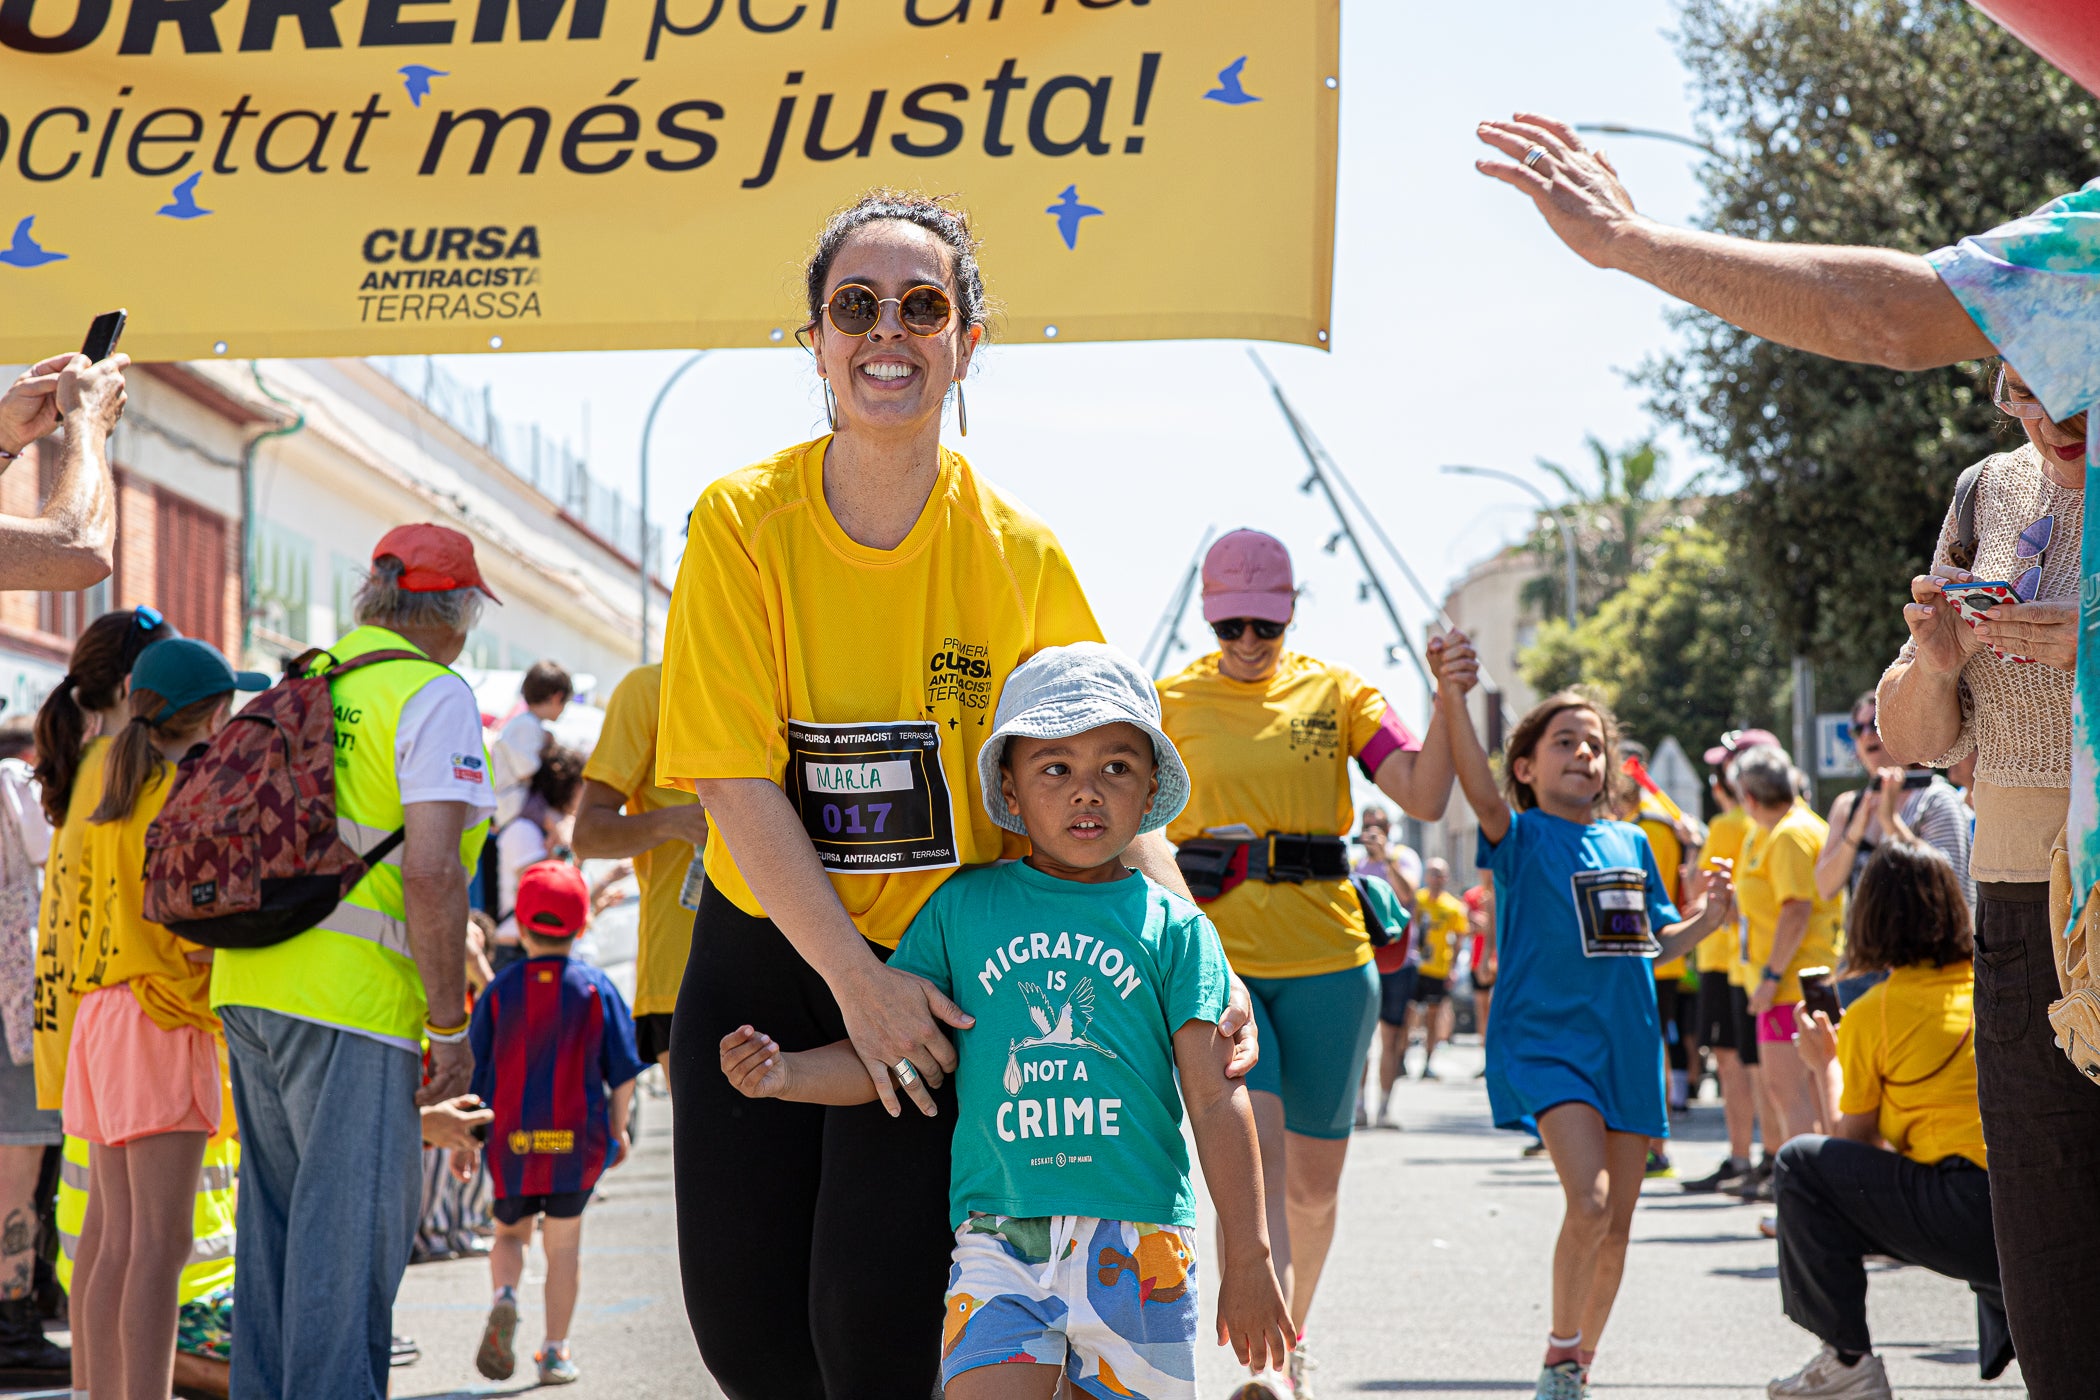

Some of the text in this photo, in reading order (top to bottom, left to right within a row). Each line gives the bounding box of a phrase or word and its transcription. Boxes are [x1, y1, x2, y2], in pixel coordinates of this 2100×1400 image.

[417, 78, 726, 176] més
[739, 52, 1163, 189] justa!
[362, 226, 541, 264] CURSA
[359, 267, 541, 291] ANTIRACISTA
[357, 291, 542, 323] TERRASSA
[943, 637, 989, 658] PRMERA
[930, 652, 992, 678] CURSA
[929, 673, 992, 693] ANTIACIST
[927, 685, 991, 709] TERASS
[804, 733, 831, 744] CURSA
[833, 732, 893, 744] ANTIRACIST
[899, 731, 934, 740] TERRASSA
[822, 803, 893, 834] 017
[911, 848, 950, 859] TERRASSA
[977, 932, 1142, 1000] MIGRATION
[1047, 970, 1067, 991] IS
[1023, 1060, 1089, 1083] NOT A
[996, 1097, 1122, 1142] CRIME
[1068, 1155, 1077, 1163] TOP
